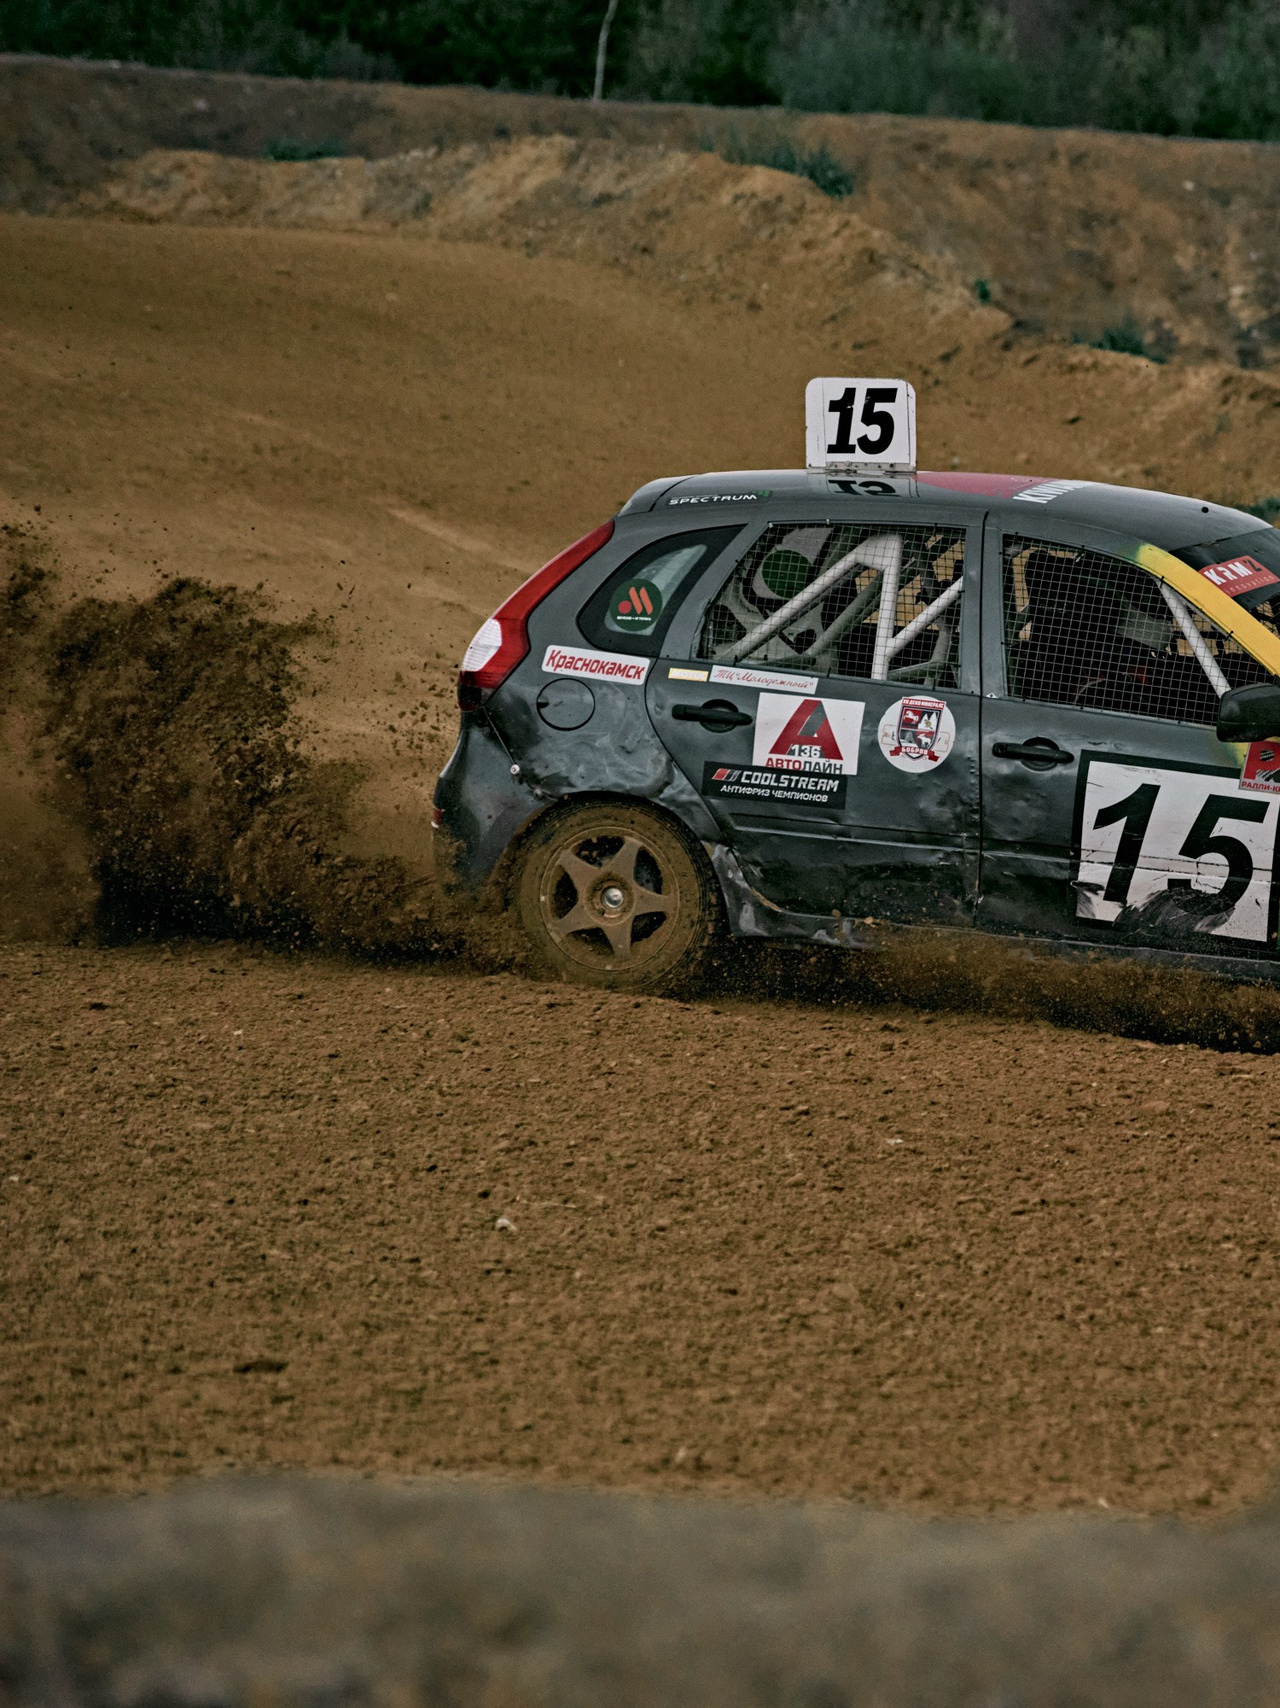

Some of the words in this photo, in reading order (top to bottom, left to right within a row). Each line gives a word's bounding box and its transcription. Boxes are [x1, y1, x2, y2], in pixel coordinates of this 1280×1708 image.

[827, 387, 898, 455] 15
[668, 494, 757, 506] SPECTRUM
[545, 649, 646, 680] Краснокамск
[791, 744, 821, 758] 136
[765, 757, 843, 775] АВТОЛАЙН
[740, 771, 840, 793] COOLSTREAM
[720, 784, 770, 797] АНТИФРИЗ
[771, 790, 829, 803] ЧЕМПИОНОВ
[1092, 782, 1271, 916] 15
